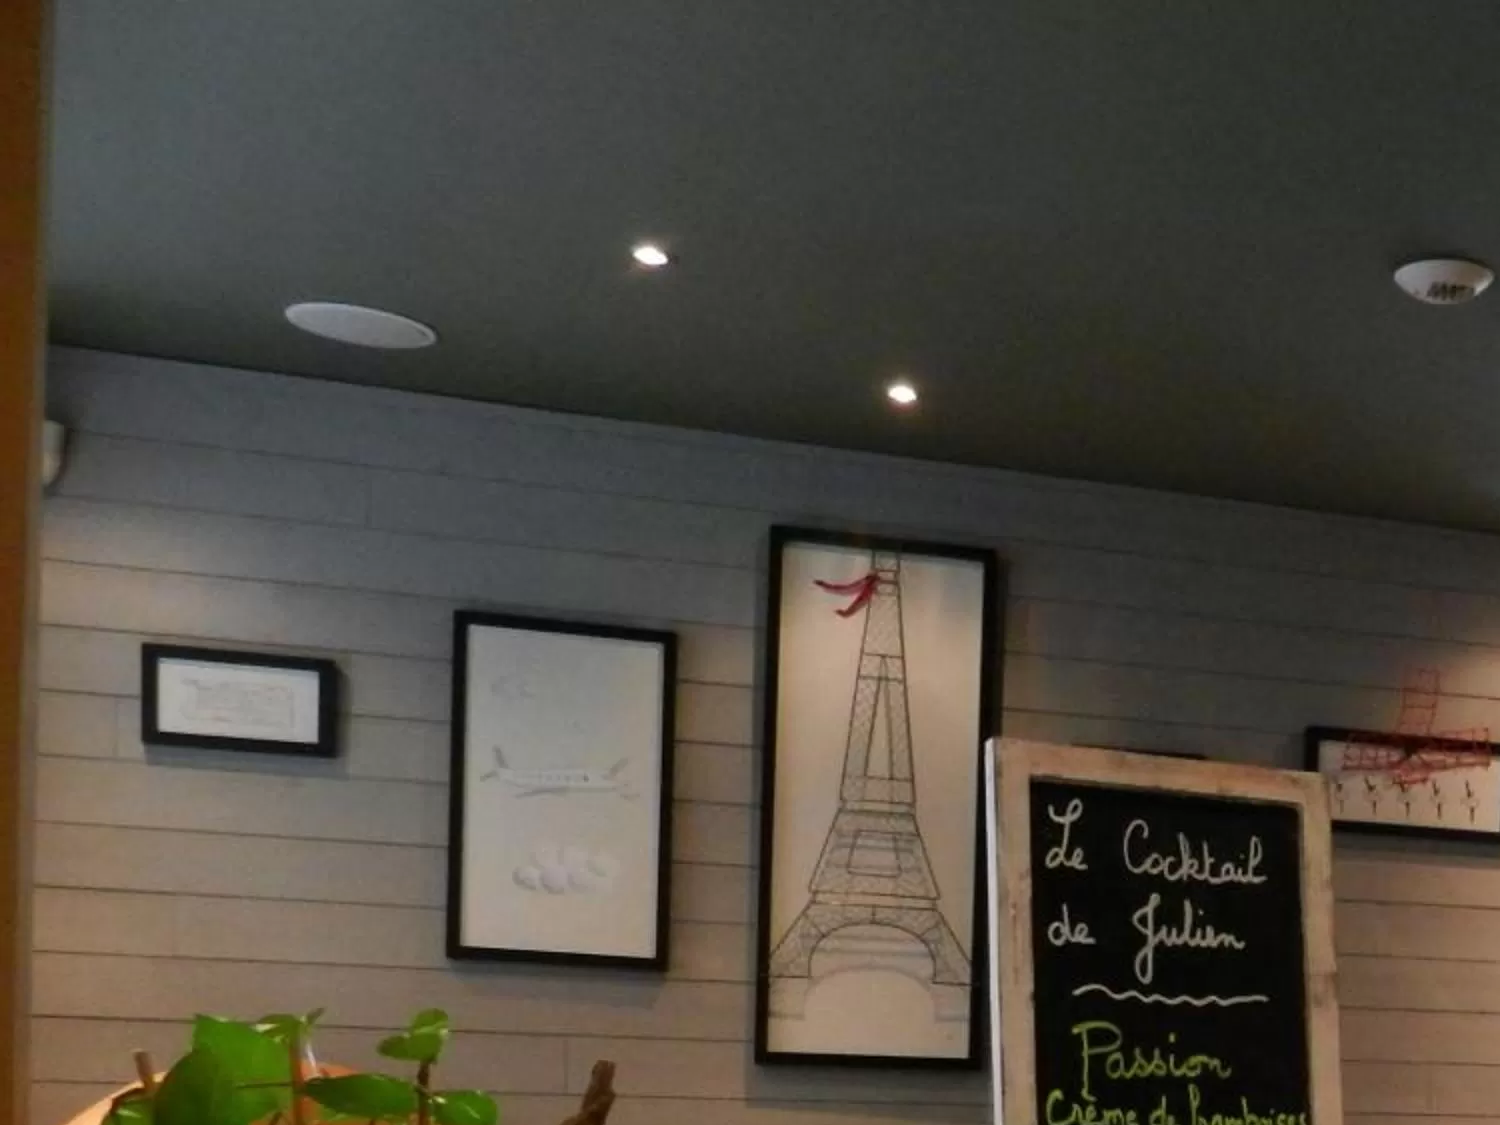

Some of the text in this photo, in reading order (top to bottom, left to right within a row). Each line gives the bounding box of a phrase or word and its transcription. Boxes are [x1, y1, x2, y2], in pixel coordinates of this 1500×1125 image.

[1045, 798, 1269, 885] Le Cocktail
[1048, 893, 1246, 985] de Julien
[1072, 1020, 1232, 1101] Passion
